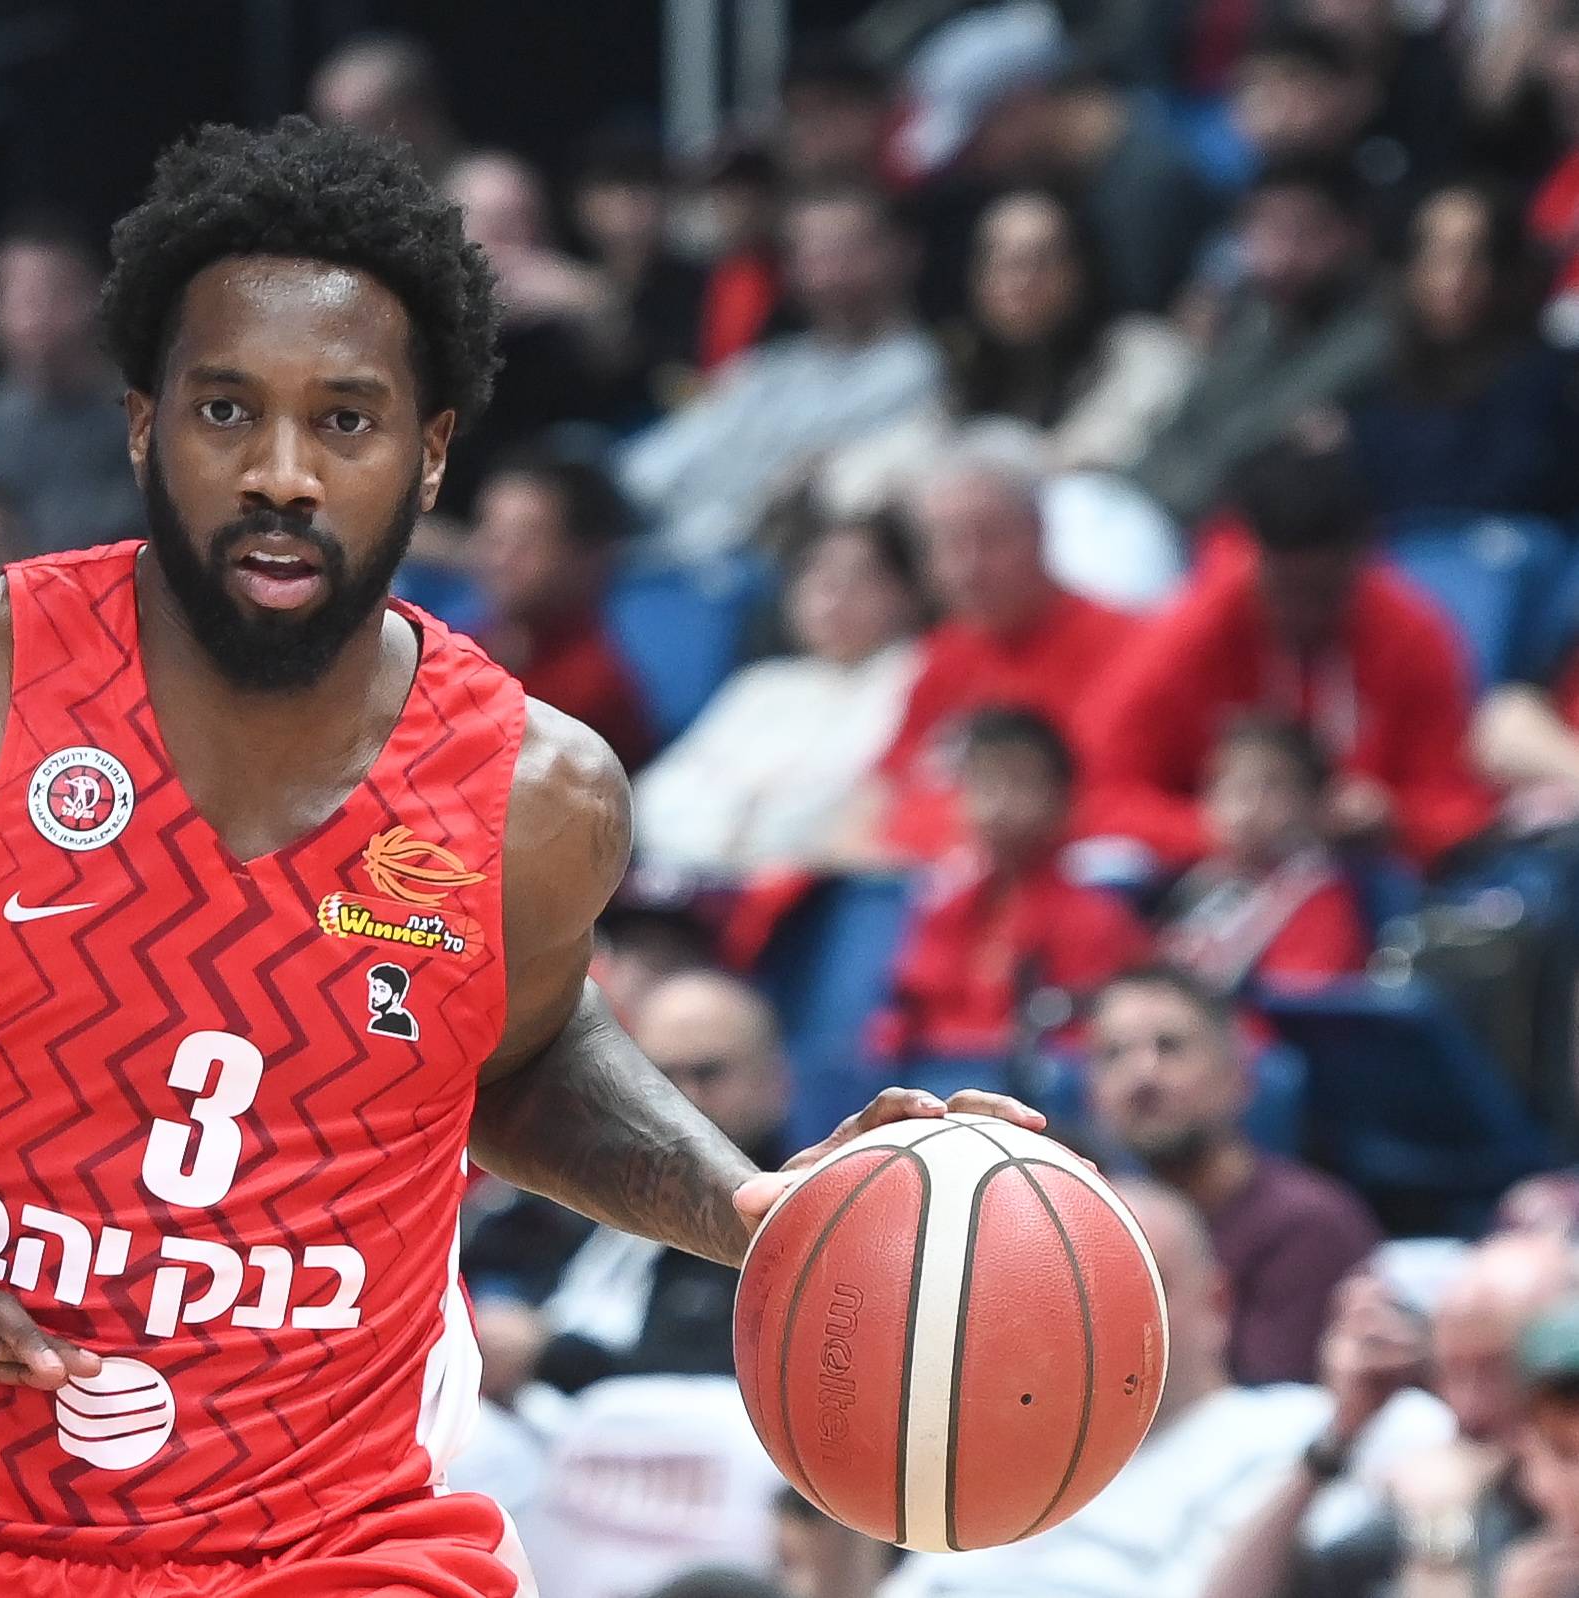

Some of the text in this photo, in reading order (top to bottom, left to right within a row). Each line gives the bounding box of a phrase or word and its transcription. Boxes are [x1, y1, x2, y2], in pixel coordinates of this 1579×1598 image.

[42, 752, 125, 785] הפועל ירושלים
[34, 803, 58, 837] HAPOEL
[339, 904, 443, 949] Winner
[406, 915, 444, 932] ליגת
[443, 931, 464, 952] סל
[141, 1029, 264, 1208] 3
[144, 1235, 367, 1338] בנק
[818, 1282, 864, 1467] molten
